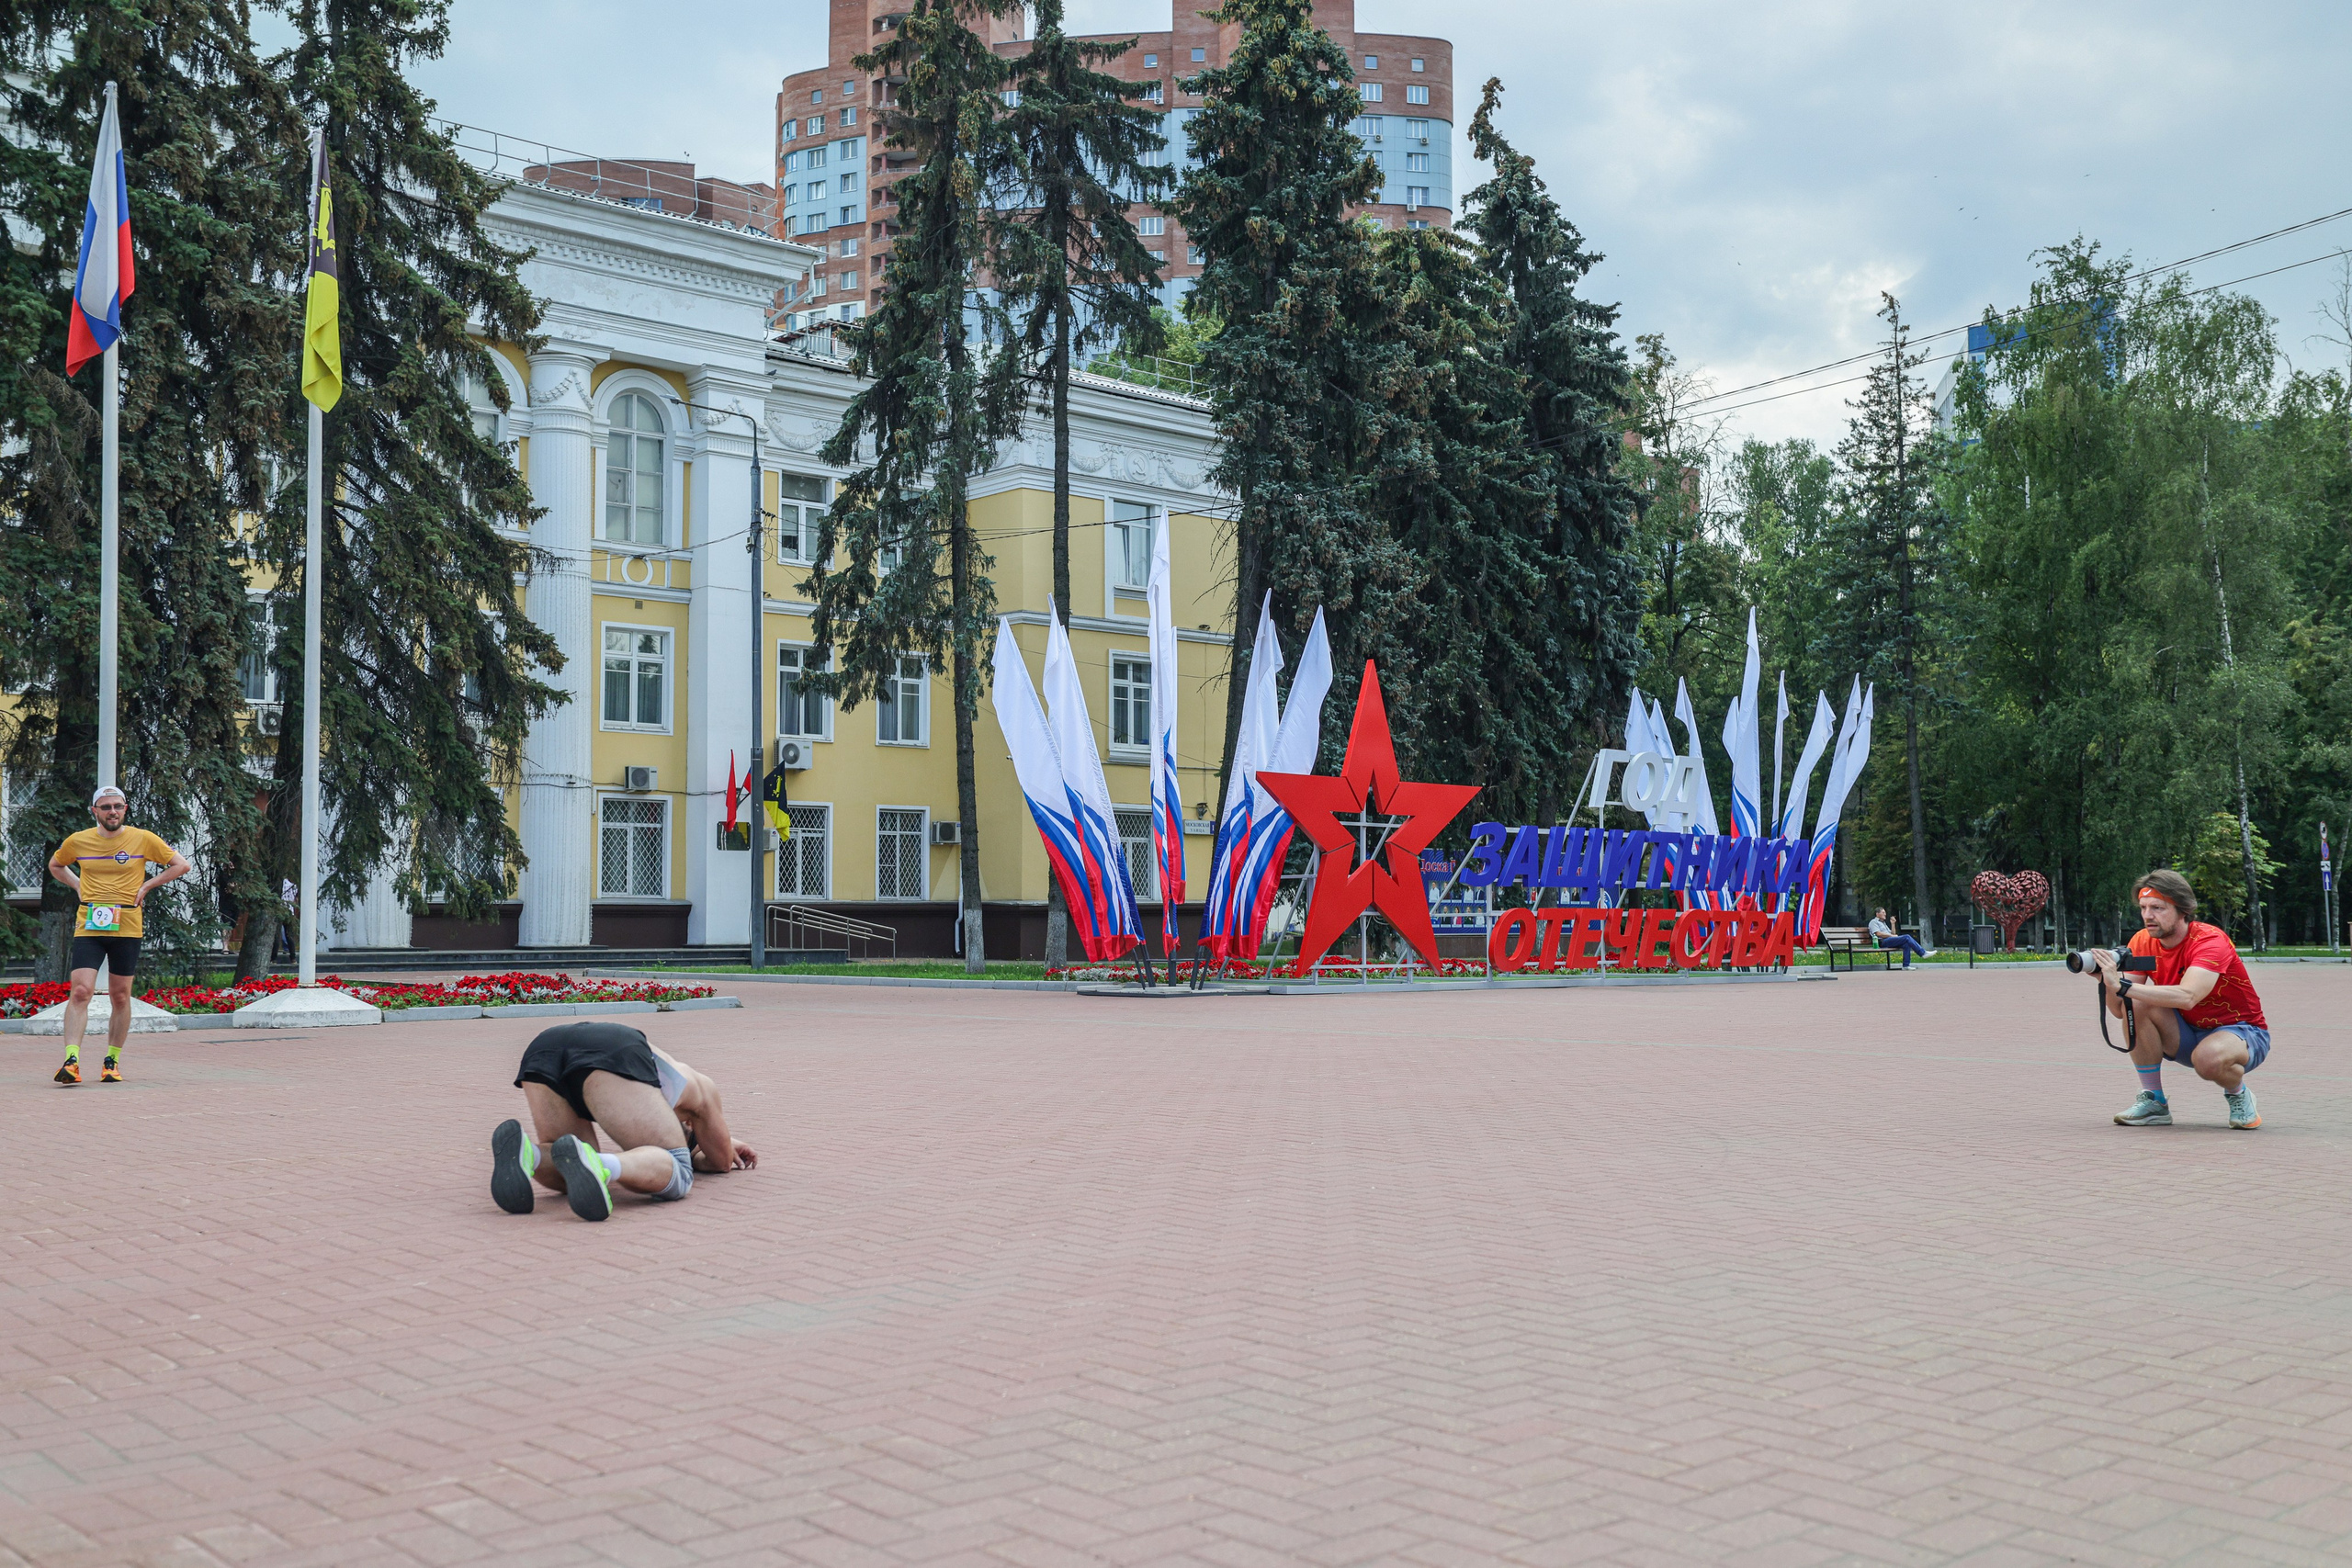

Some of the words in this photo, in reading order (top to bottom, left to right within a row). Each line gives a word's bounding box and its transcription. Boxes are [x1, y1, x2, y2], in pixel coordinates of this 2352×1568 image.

[1589, 749, 1704, 826] ГОД
[1459, 821, 1810, 902] ЗАЩИТНИКА
[1488, 907, 1794, 974] ОТЕЧЕСТВА
